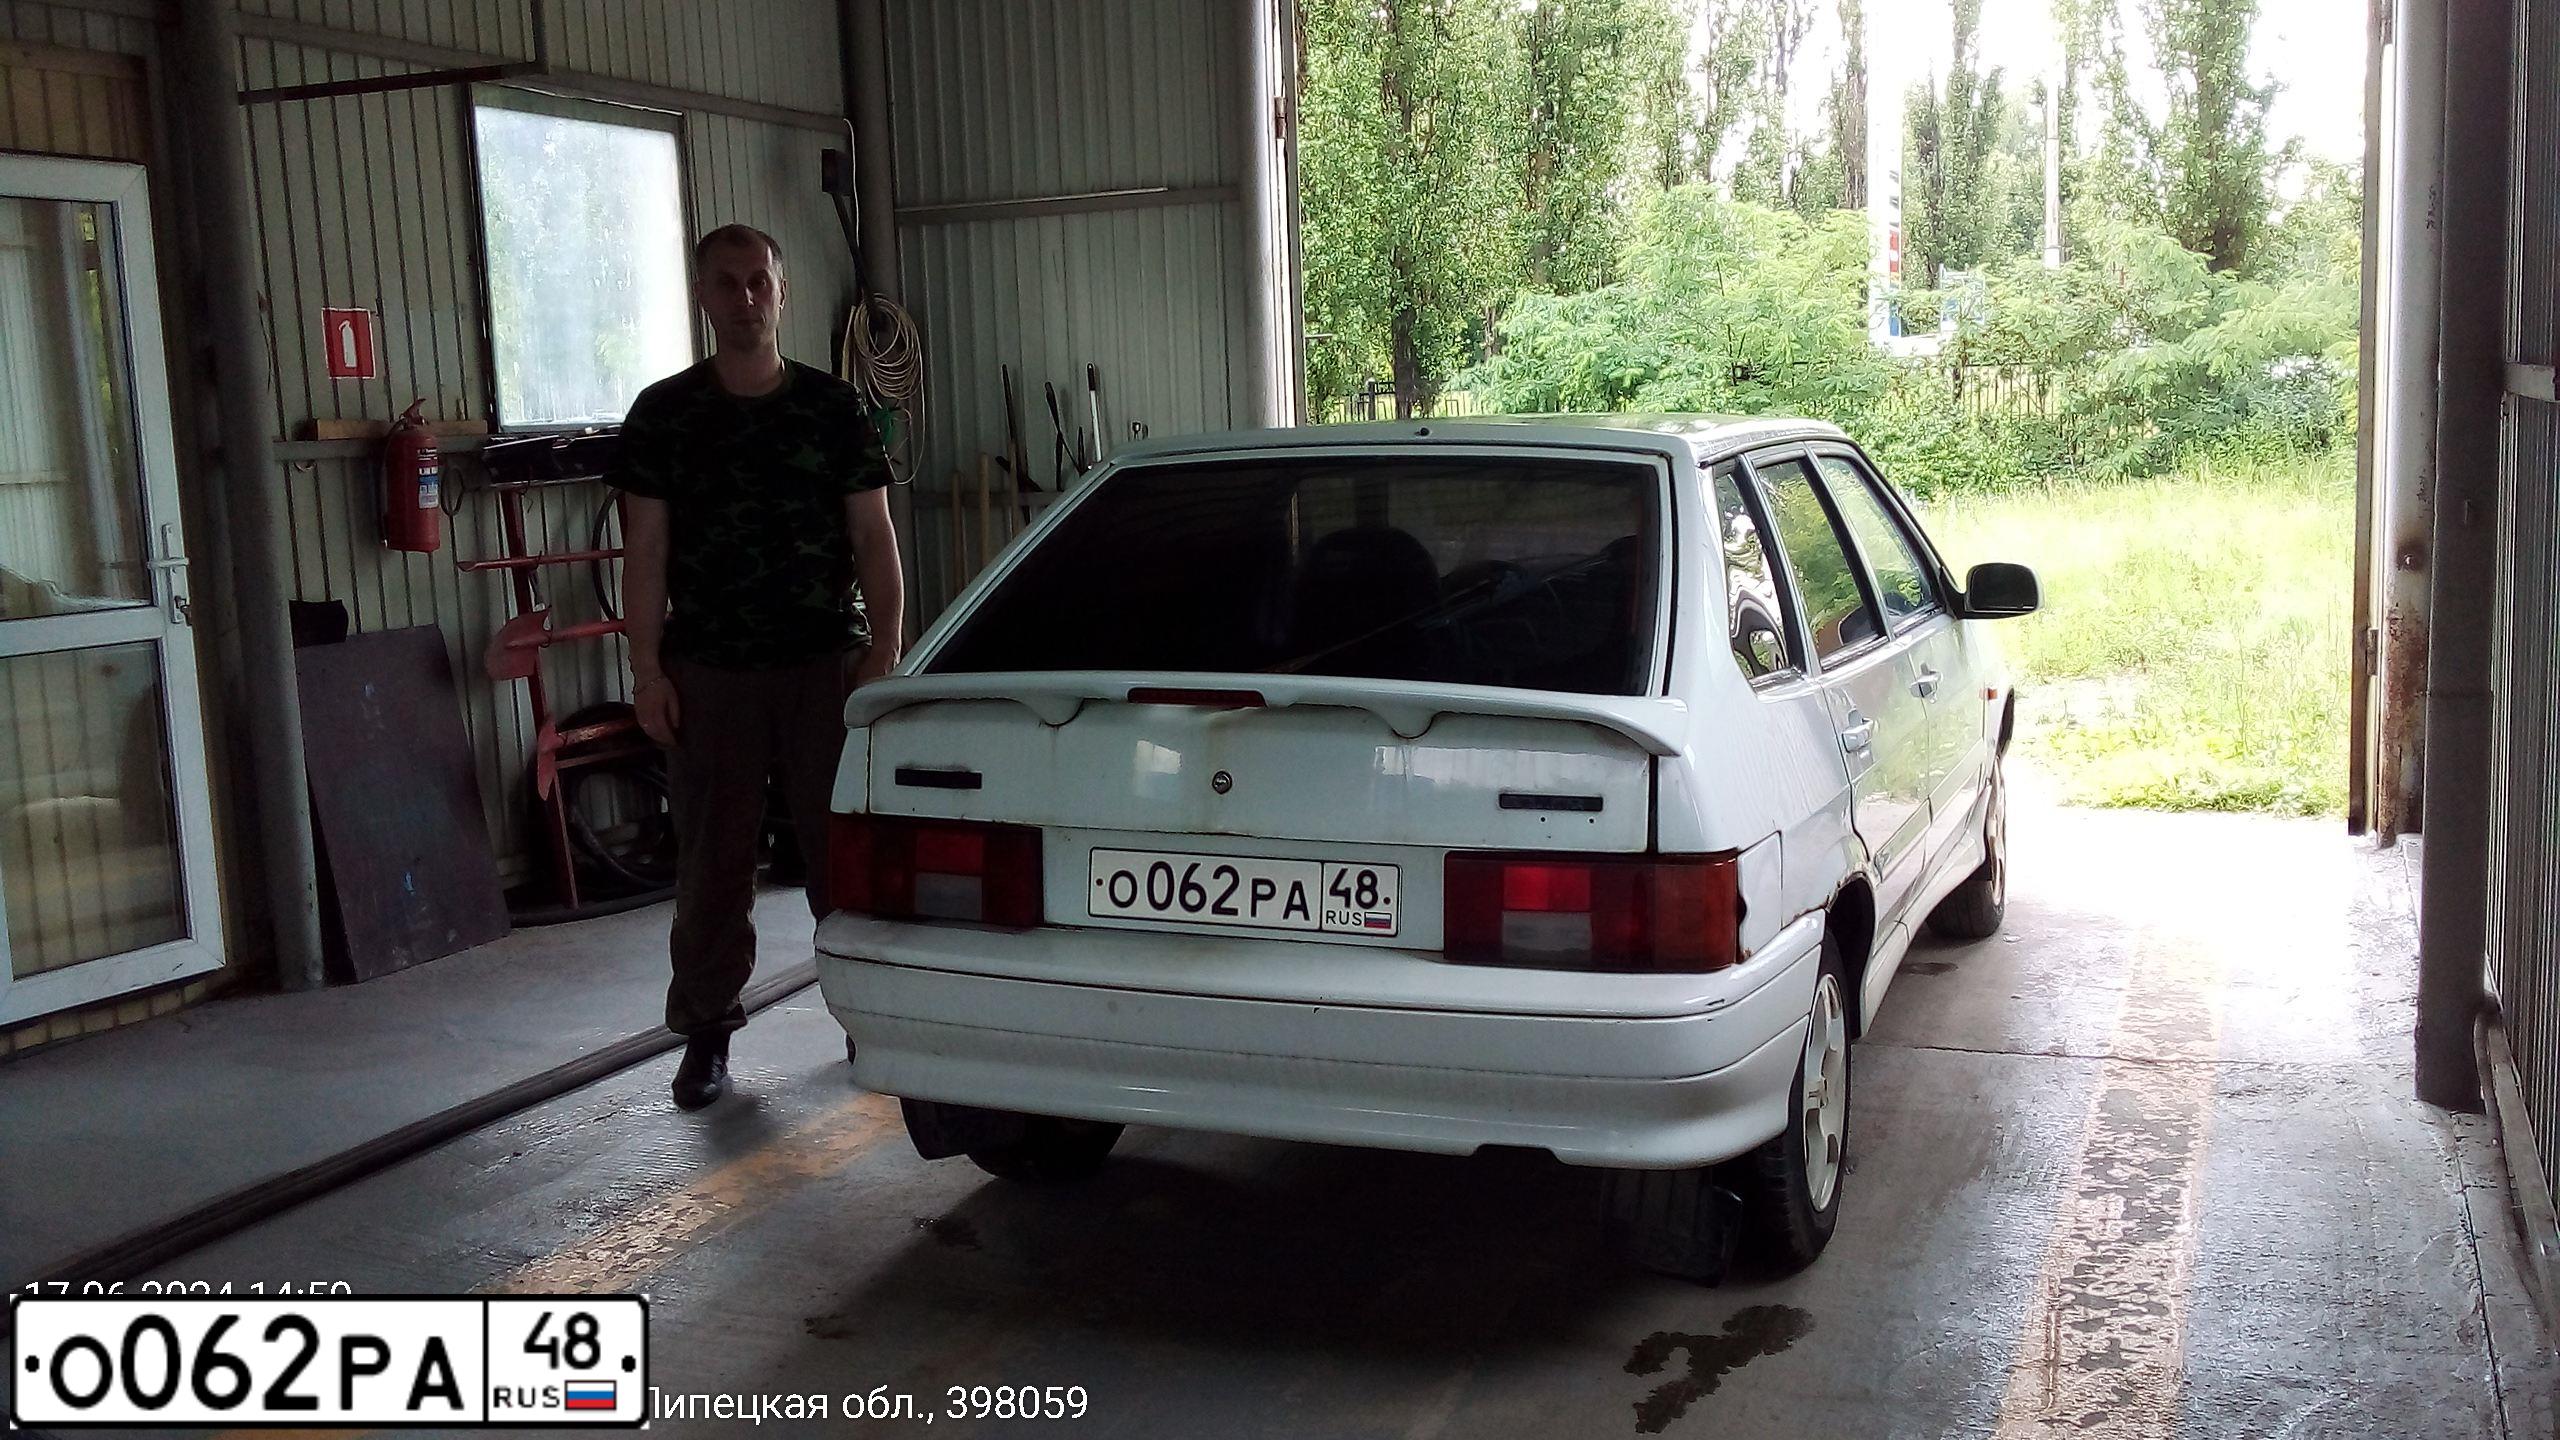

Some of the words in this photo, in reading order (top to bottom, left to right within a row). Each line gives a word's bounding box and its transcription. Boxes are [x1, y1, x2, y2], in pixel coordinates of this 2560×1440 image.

[1108, 861, 1311, 921] О062РА
[1329, 868, 1379, 910] 48
[1325, 910, 1363, 926] RUS
